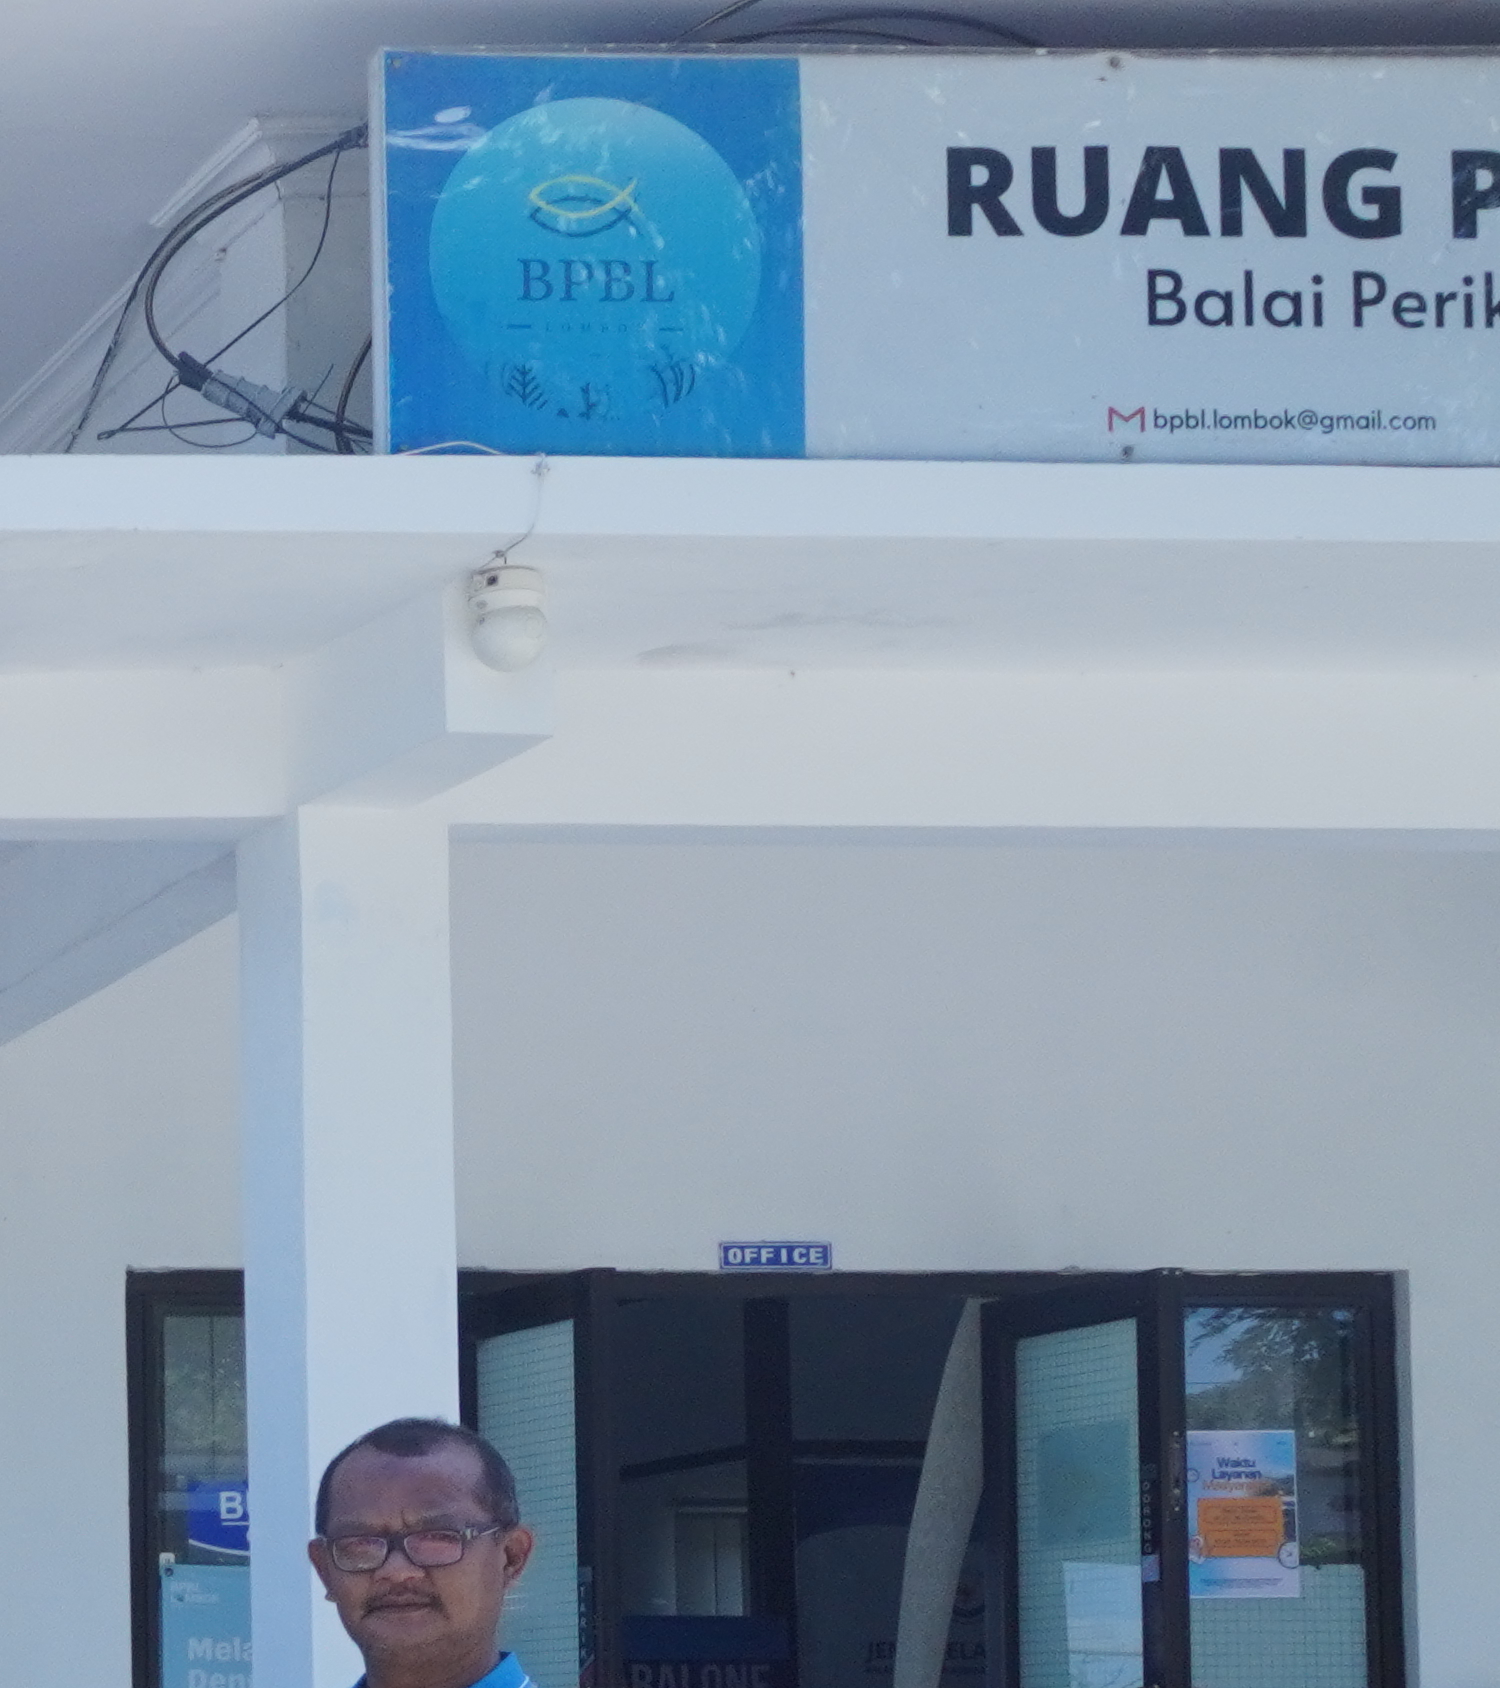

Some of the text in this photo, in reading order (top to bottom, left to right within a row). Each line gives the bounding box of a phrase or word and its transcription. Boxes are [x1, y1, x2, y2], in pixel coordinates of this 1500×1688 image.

[946, 145, 1402, 240] RUANG
[516, 257, 675, 302] BPBL
[1146, 268, 1324, 328] Balai
[1152, 408, 1438, 435] bpbl.lombok@gmail.com
[727, 1247, 825, 1265] OFFICE
[1211, 1468, 1263, 1481] Layanan
[1216, 1456, 1257, 1469] Waktu
